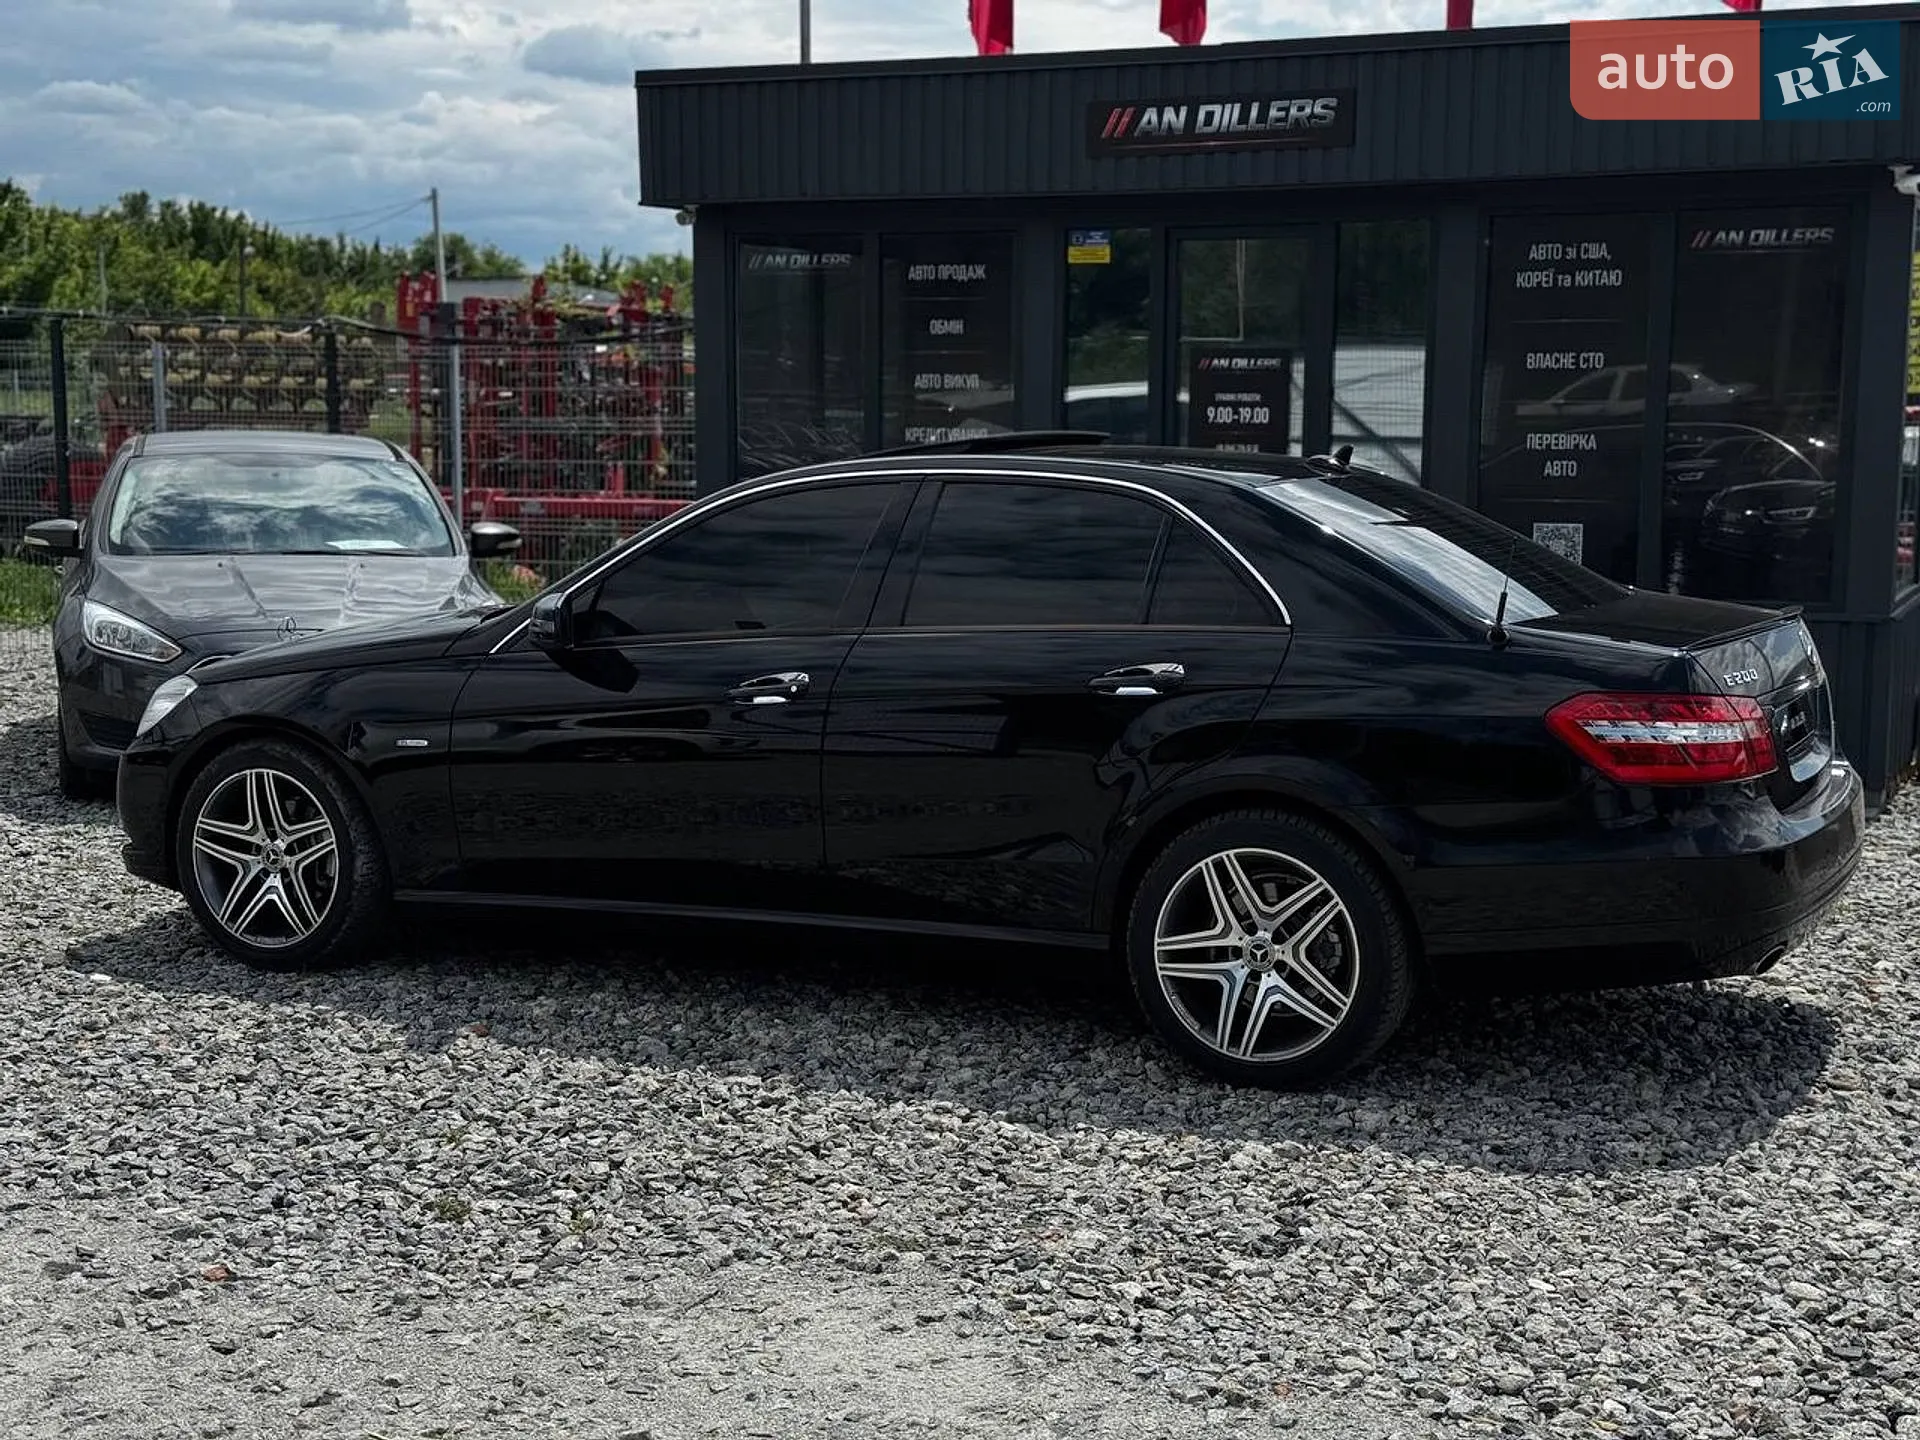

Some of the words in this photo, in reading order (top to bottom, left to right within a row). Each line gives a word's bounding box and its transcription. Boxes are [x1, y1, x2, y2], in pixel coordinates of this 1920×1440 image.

[1195, 97, 1338, 135] DILLERS
[1748, 227, 1835, 247] DILLERS
[790, 252, 853, 269] DILLERS
[1528, 242, 1562, 260] АВТО
[1565, 243, 1577, 260] зі
[1580, 242, 1612, 261] США,
[908, 264, 936, 281] АВТО
[938, 263, 987, 283] ПРОДАЖ
[1515, 268, 1554, 289] КОРЕЇ
[1557, 273, 1572, 287] та
[1575, 269, 1623, 288] КИТАЮ
[929, 318, 965, 336] ОБМІН
[1526, 351, 1577, 370] ВЛАСНЕ
[1579, 351, 1605, 369] СТО
[914, 373, 941, 389] АВТО
[943, 372, 980, 390] ВИКУП
[1206, 405, 1270, 424] 9.00-19.00
[1526, 432, 1598, 451] ПЕРЕВІРКА
[1543, 460, 1578, 478] АВТО
